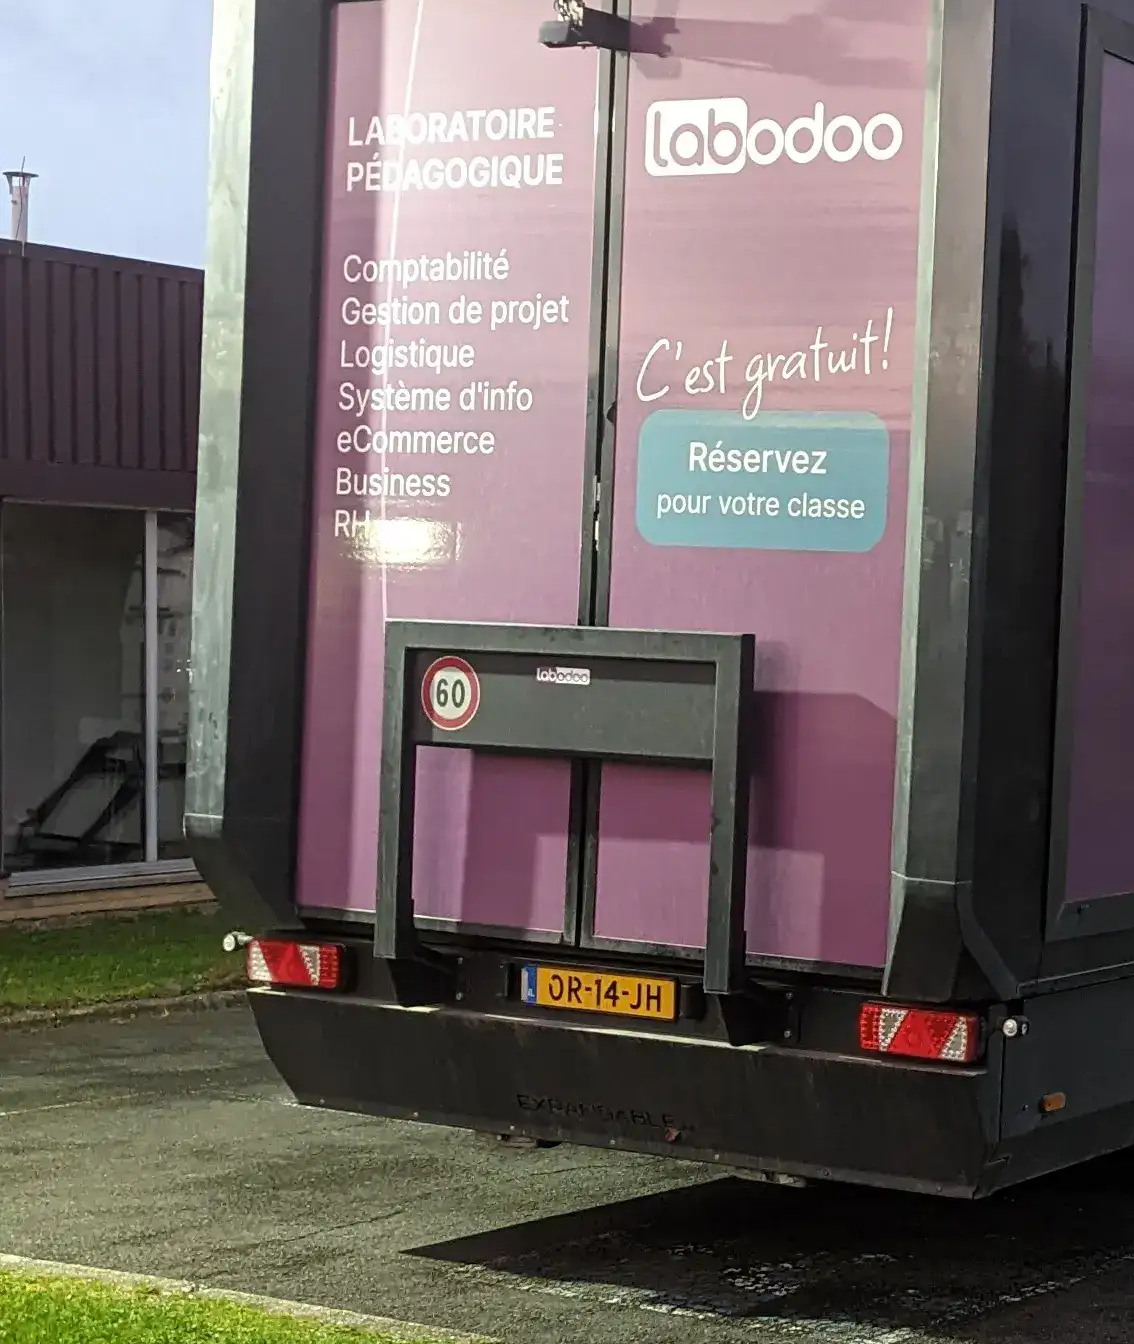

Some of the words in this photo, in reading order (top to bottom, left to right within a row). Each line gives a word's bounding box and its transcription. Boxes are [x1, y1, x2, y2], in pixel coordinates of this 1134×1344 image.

[348, 106, 556, 146] LABORATOIRE
[653, 100, 903, 168] labodoo
[346, 152, 564, 192] PÉDAGOGIQUE
[343, 248, 510, 289] Comptabilité
[341, 296, 440, 326] Gestion
[449, 294, 483, 324] de
[490, 292, 570, 331] projet
[340, 338, 475, 375] Logistique
[636, 338, 734, 402] C'est
[742, 306, 894, 421] gratuit!
[338, 379, 451, 417] Système
[459, 380, 534, 412] d'info
[337, 424, 496, 454] eCommerce
[688, 440, 828, 475] Réservez
[336, 466, 451, 498] Business
[657, 492, 712, 519] pour
[718, 492, 780, 517] votre
[787, 492, 866, 519] classe
[436, 677, 466, 708] 60
[536, 667, 590, 684] labodoo
[548, 974, 662, 1013] OR-14-JH
